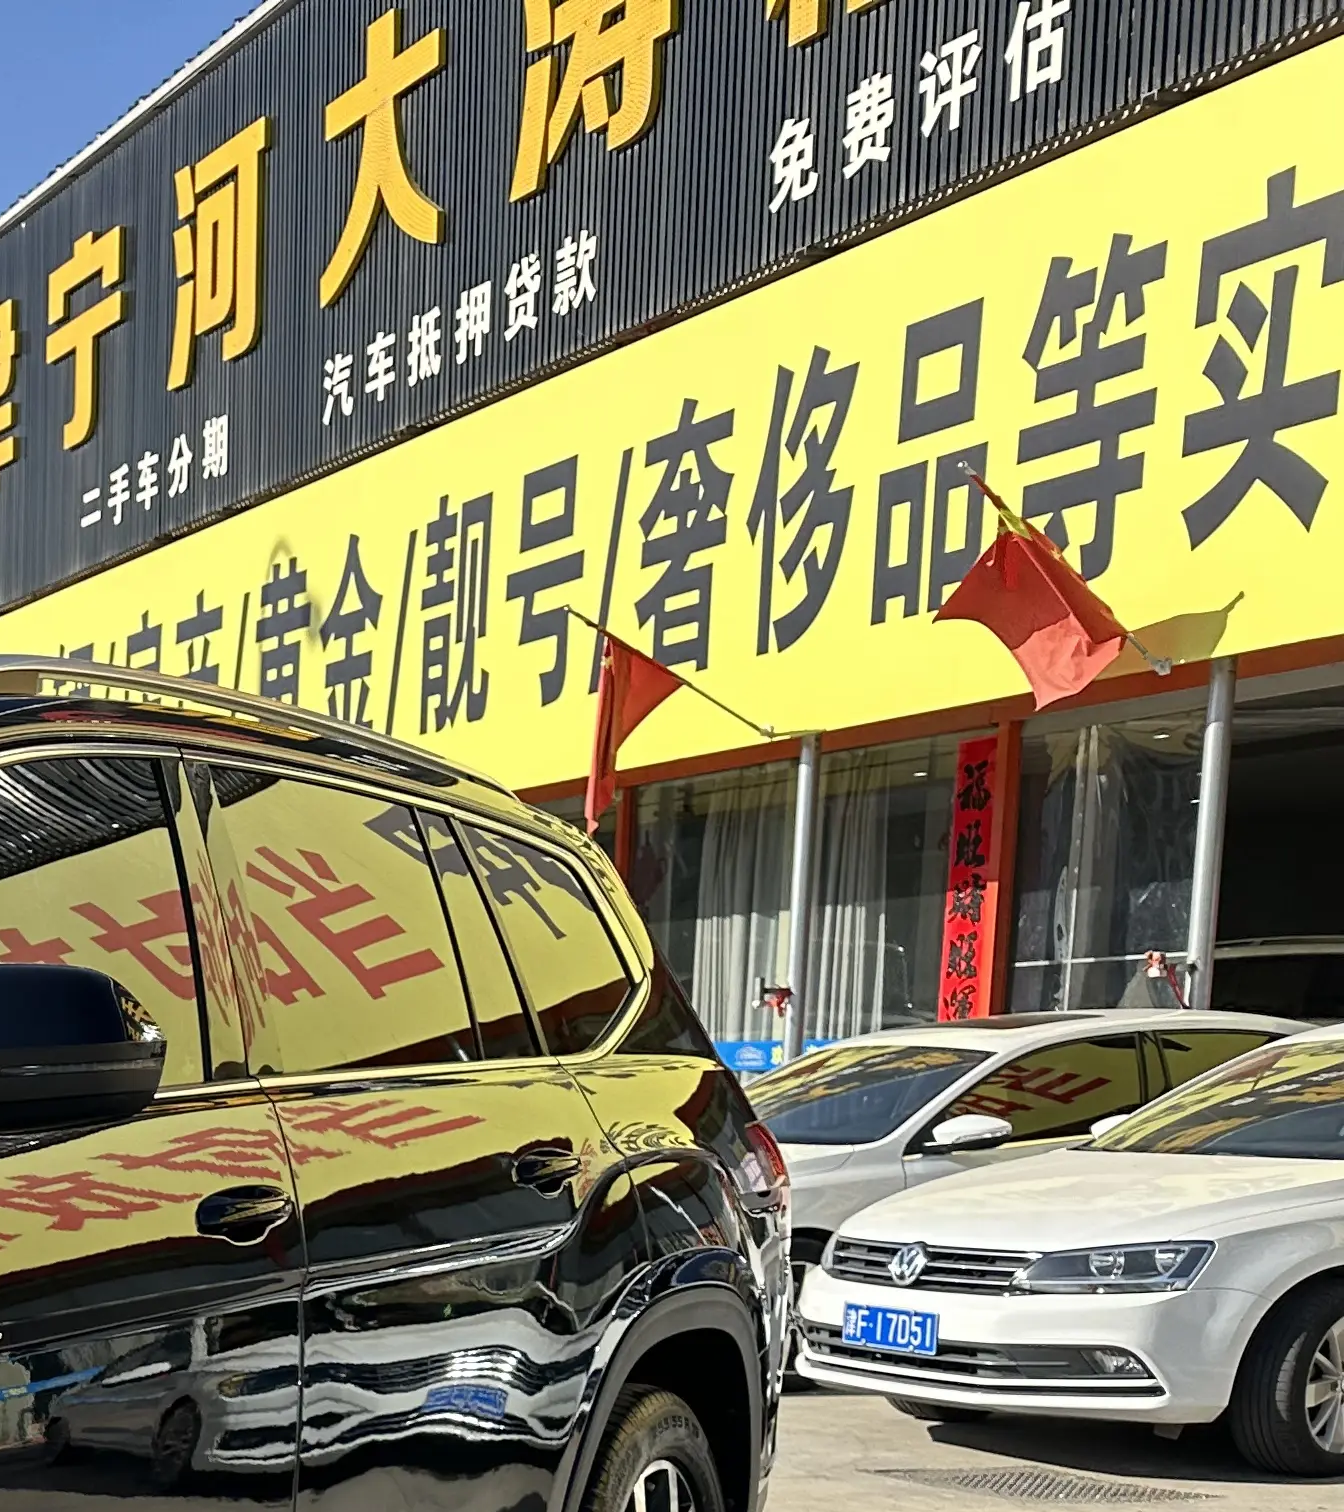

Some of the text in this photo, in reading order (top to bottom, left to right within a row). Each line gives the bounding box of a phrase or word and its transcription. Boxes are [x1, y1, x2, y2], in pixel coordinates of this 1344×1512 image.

[768, 0, 1072, 213] 免费评估
[322, 229, 597, 426] 汽车抵押贷款
[80, 414, 229, 528] 二手车分期
